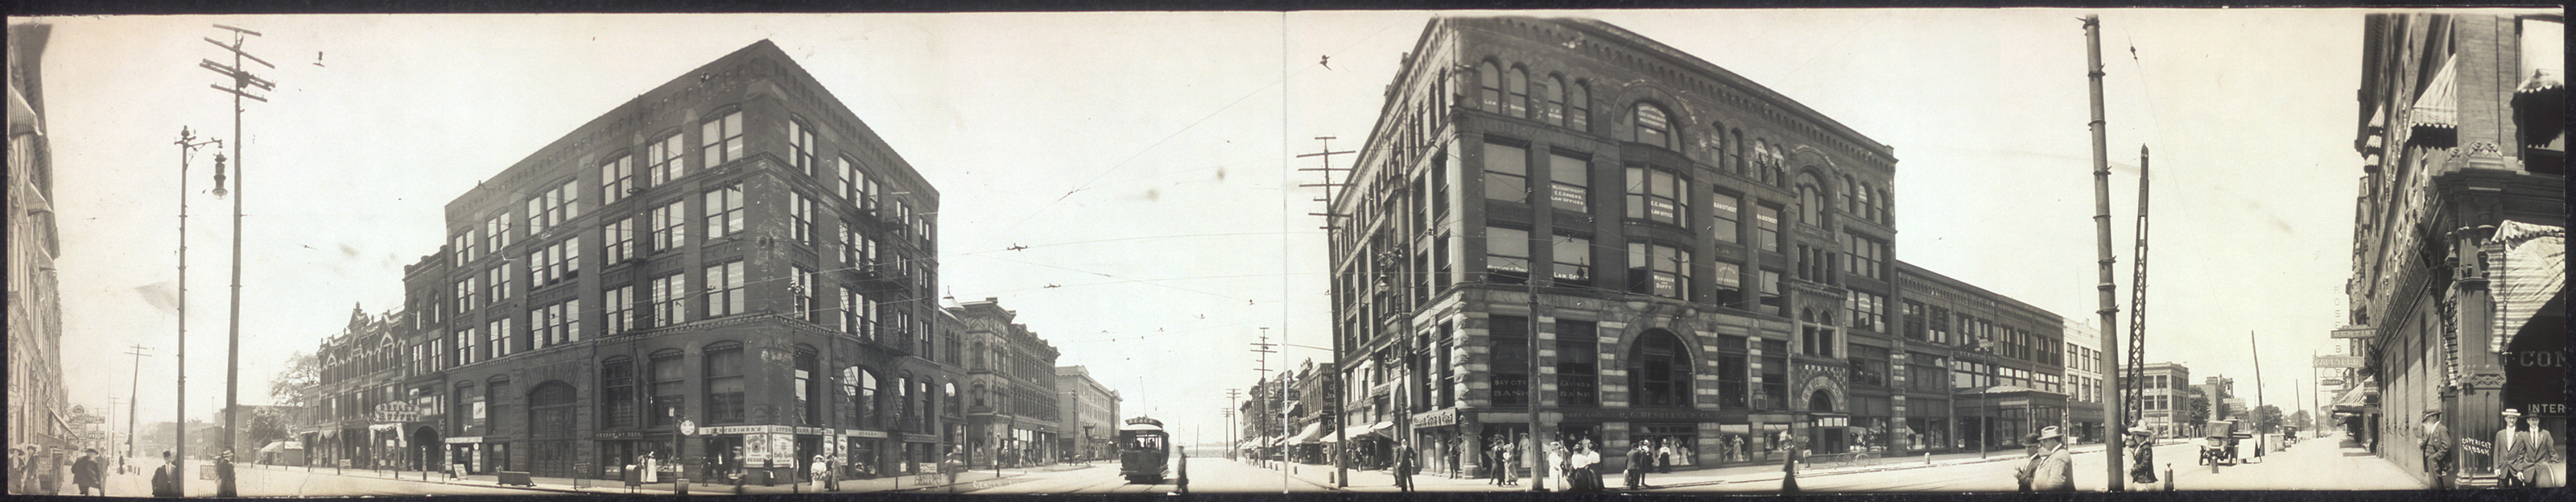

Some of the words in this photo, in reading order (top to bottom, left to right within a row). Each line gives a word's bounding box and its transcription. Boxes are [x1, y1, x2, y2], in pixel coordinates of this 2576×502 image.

[2314, 357, 2365, 367] CAFETERIA
[1493, 389, 1530, 397] BANK
[1559, 390, 1591, 398] BANK
